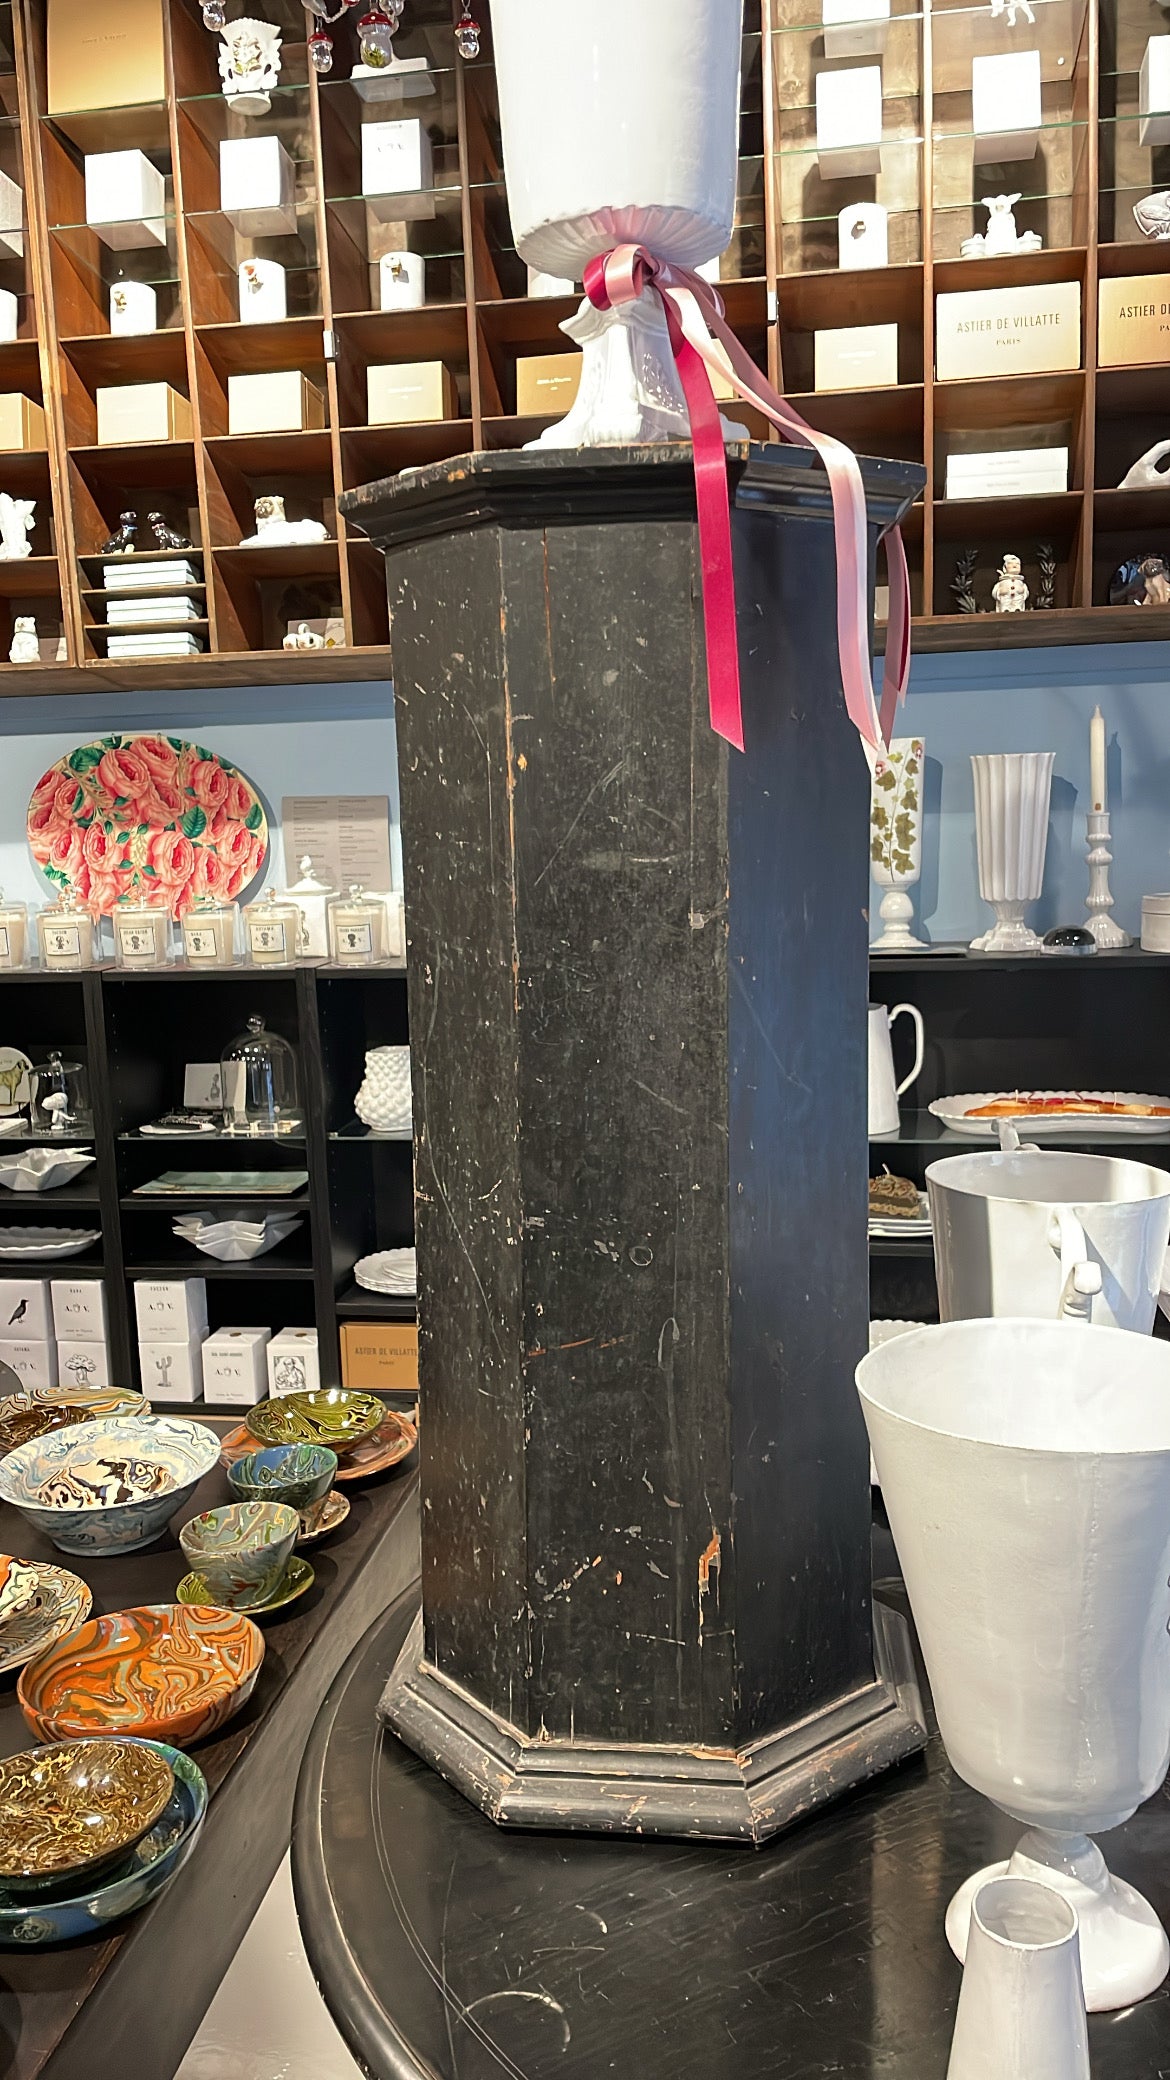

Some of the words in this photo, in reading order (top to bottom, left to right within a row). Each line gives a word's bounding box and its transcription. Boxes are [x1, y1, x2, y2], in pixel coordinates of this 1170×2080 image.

[1119, 304, 1155, 319] ASTIER
[957, 319, 992, 334] ASTIER
[997, 318, 1009, 330] DE
[1013, 313, 1061, 328] VILLATTE
